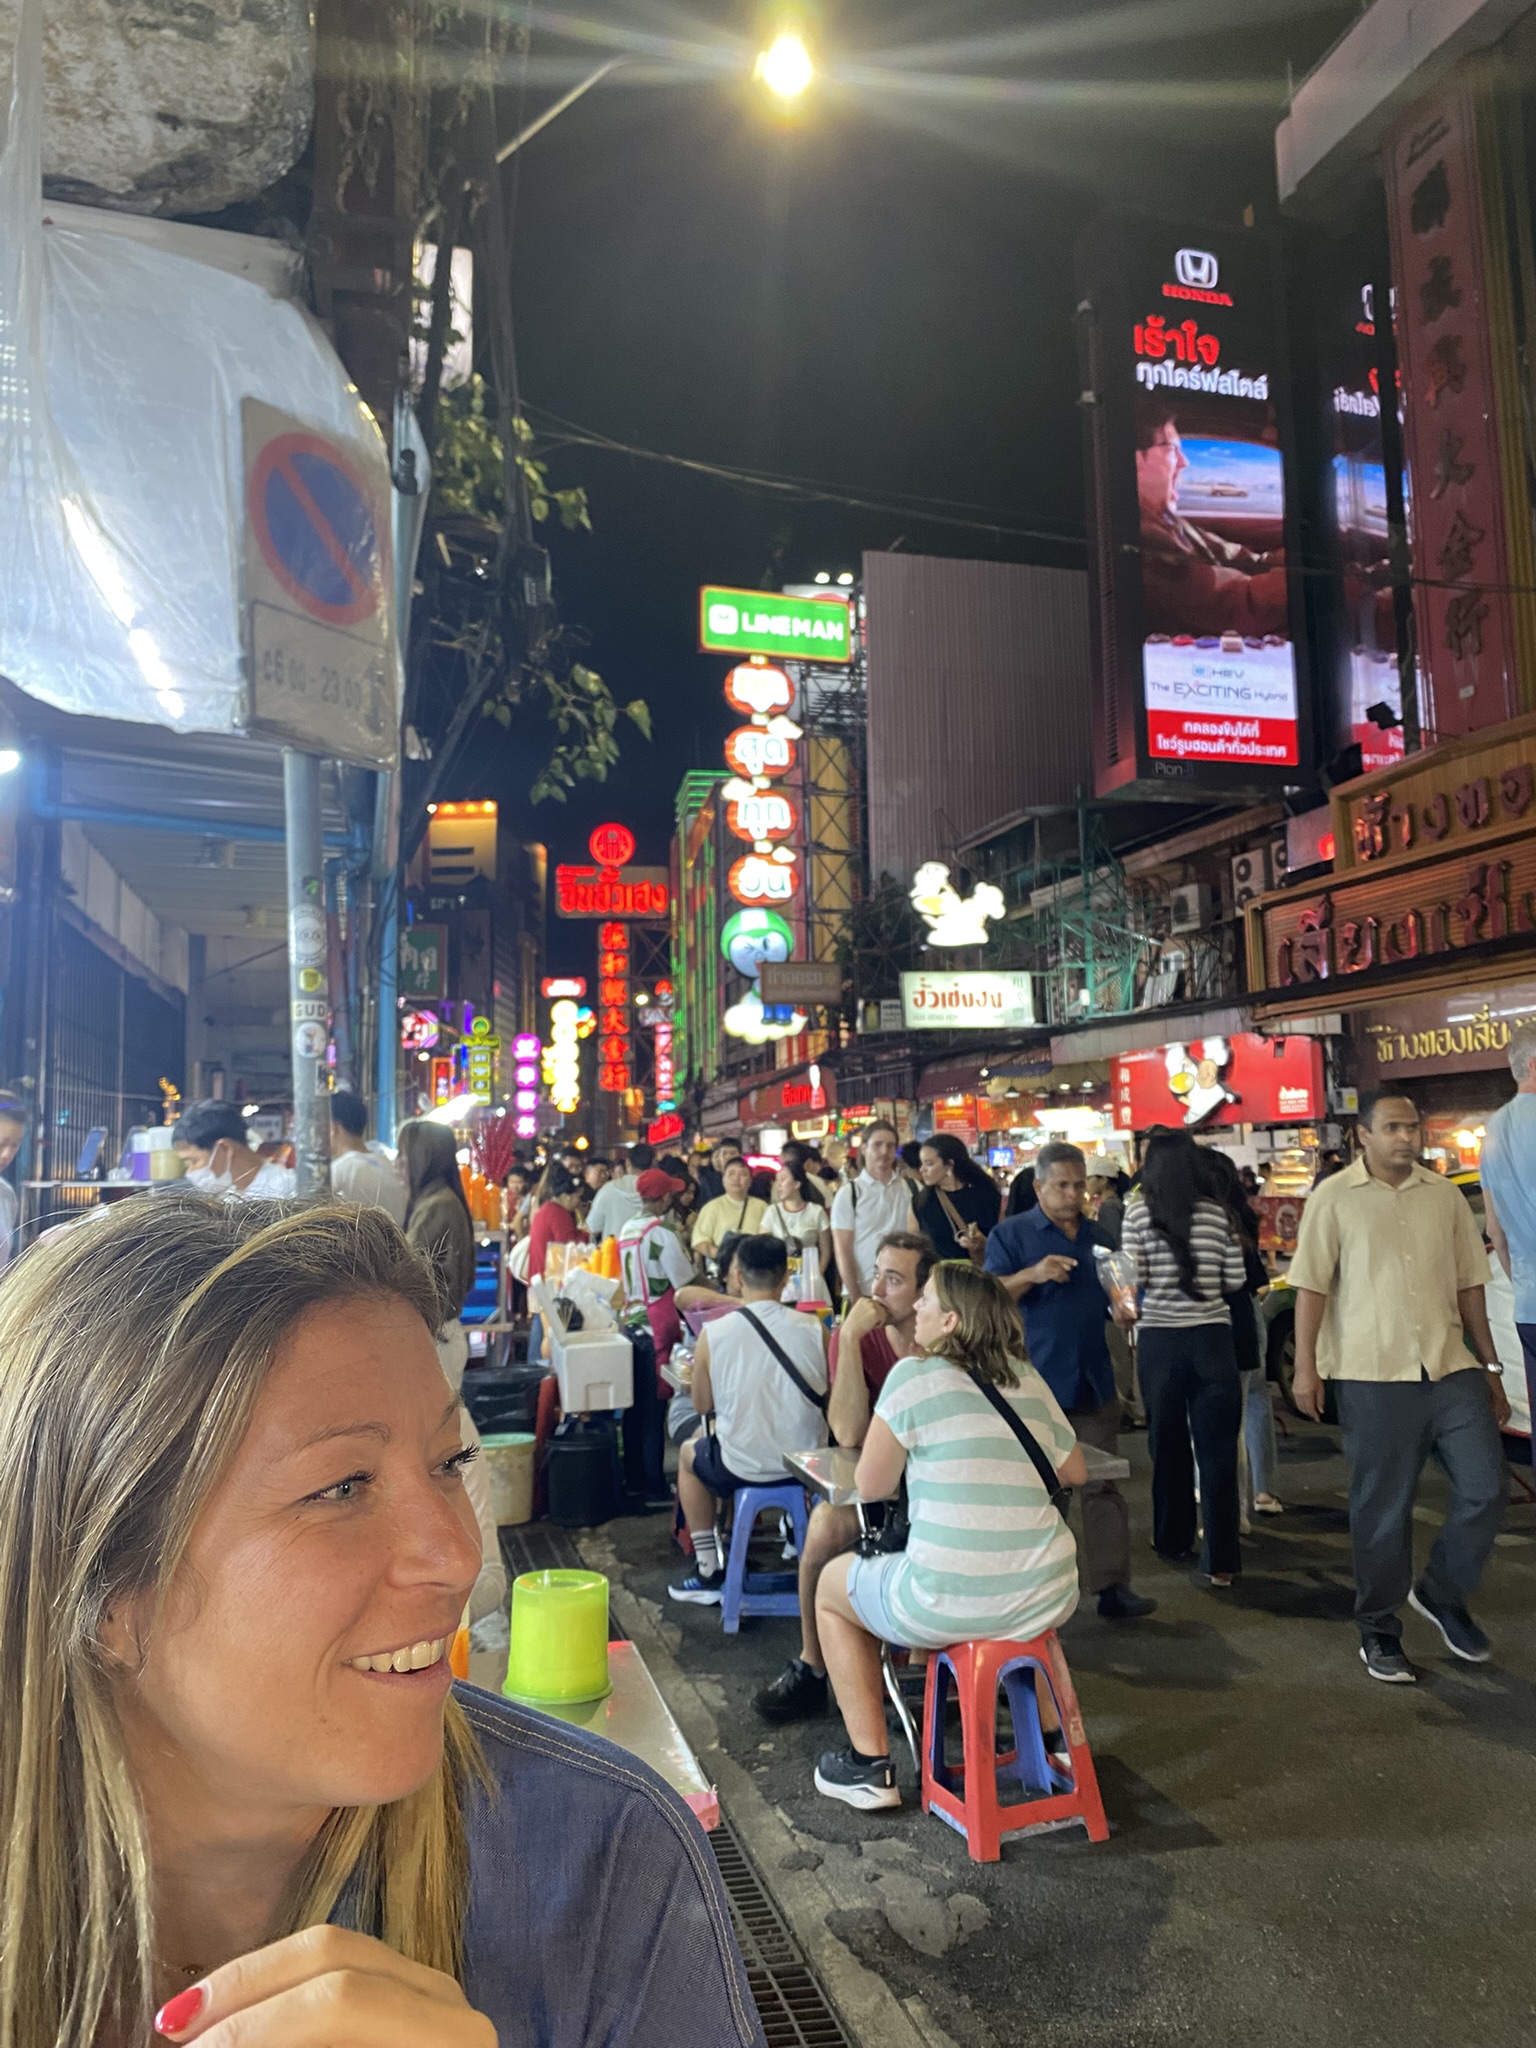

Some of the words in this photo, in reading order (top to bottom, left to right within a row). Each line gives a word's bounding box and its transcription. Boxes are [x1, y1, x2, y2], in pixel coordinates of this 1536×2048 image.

[1161, 283, 1234, 307] HONDA
[1133, 314, 1220, 366] เร้าใจ
[742, 612, 791, 636] LINE
[792, 616, 844, 641] MAN
[1150, 682, 1171, 693] The
[1174, 681, 1252, 700] EXCITING
[1254, 689, 1288, 703] Hybrid
[1376, 1003, 1511, 1064] ห้างทองเลี่ย
